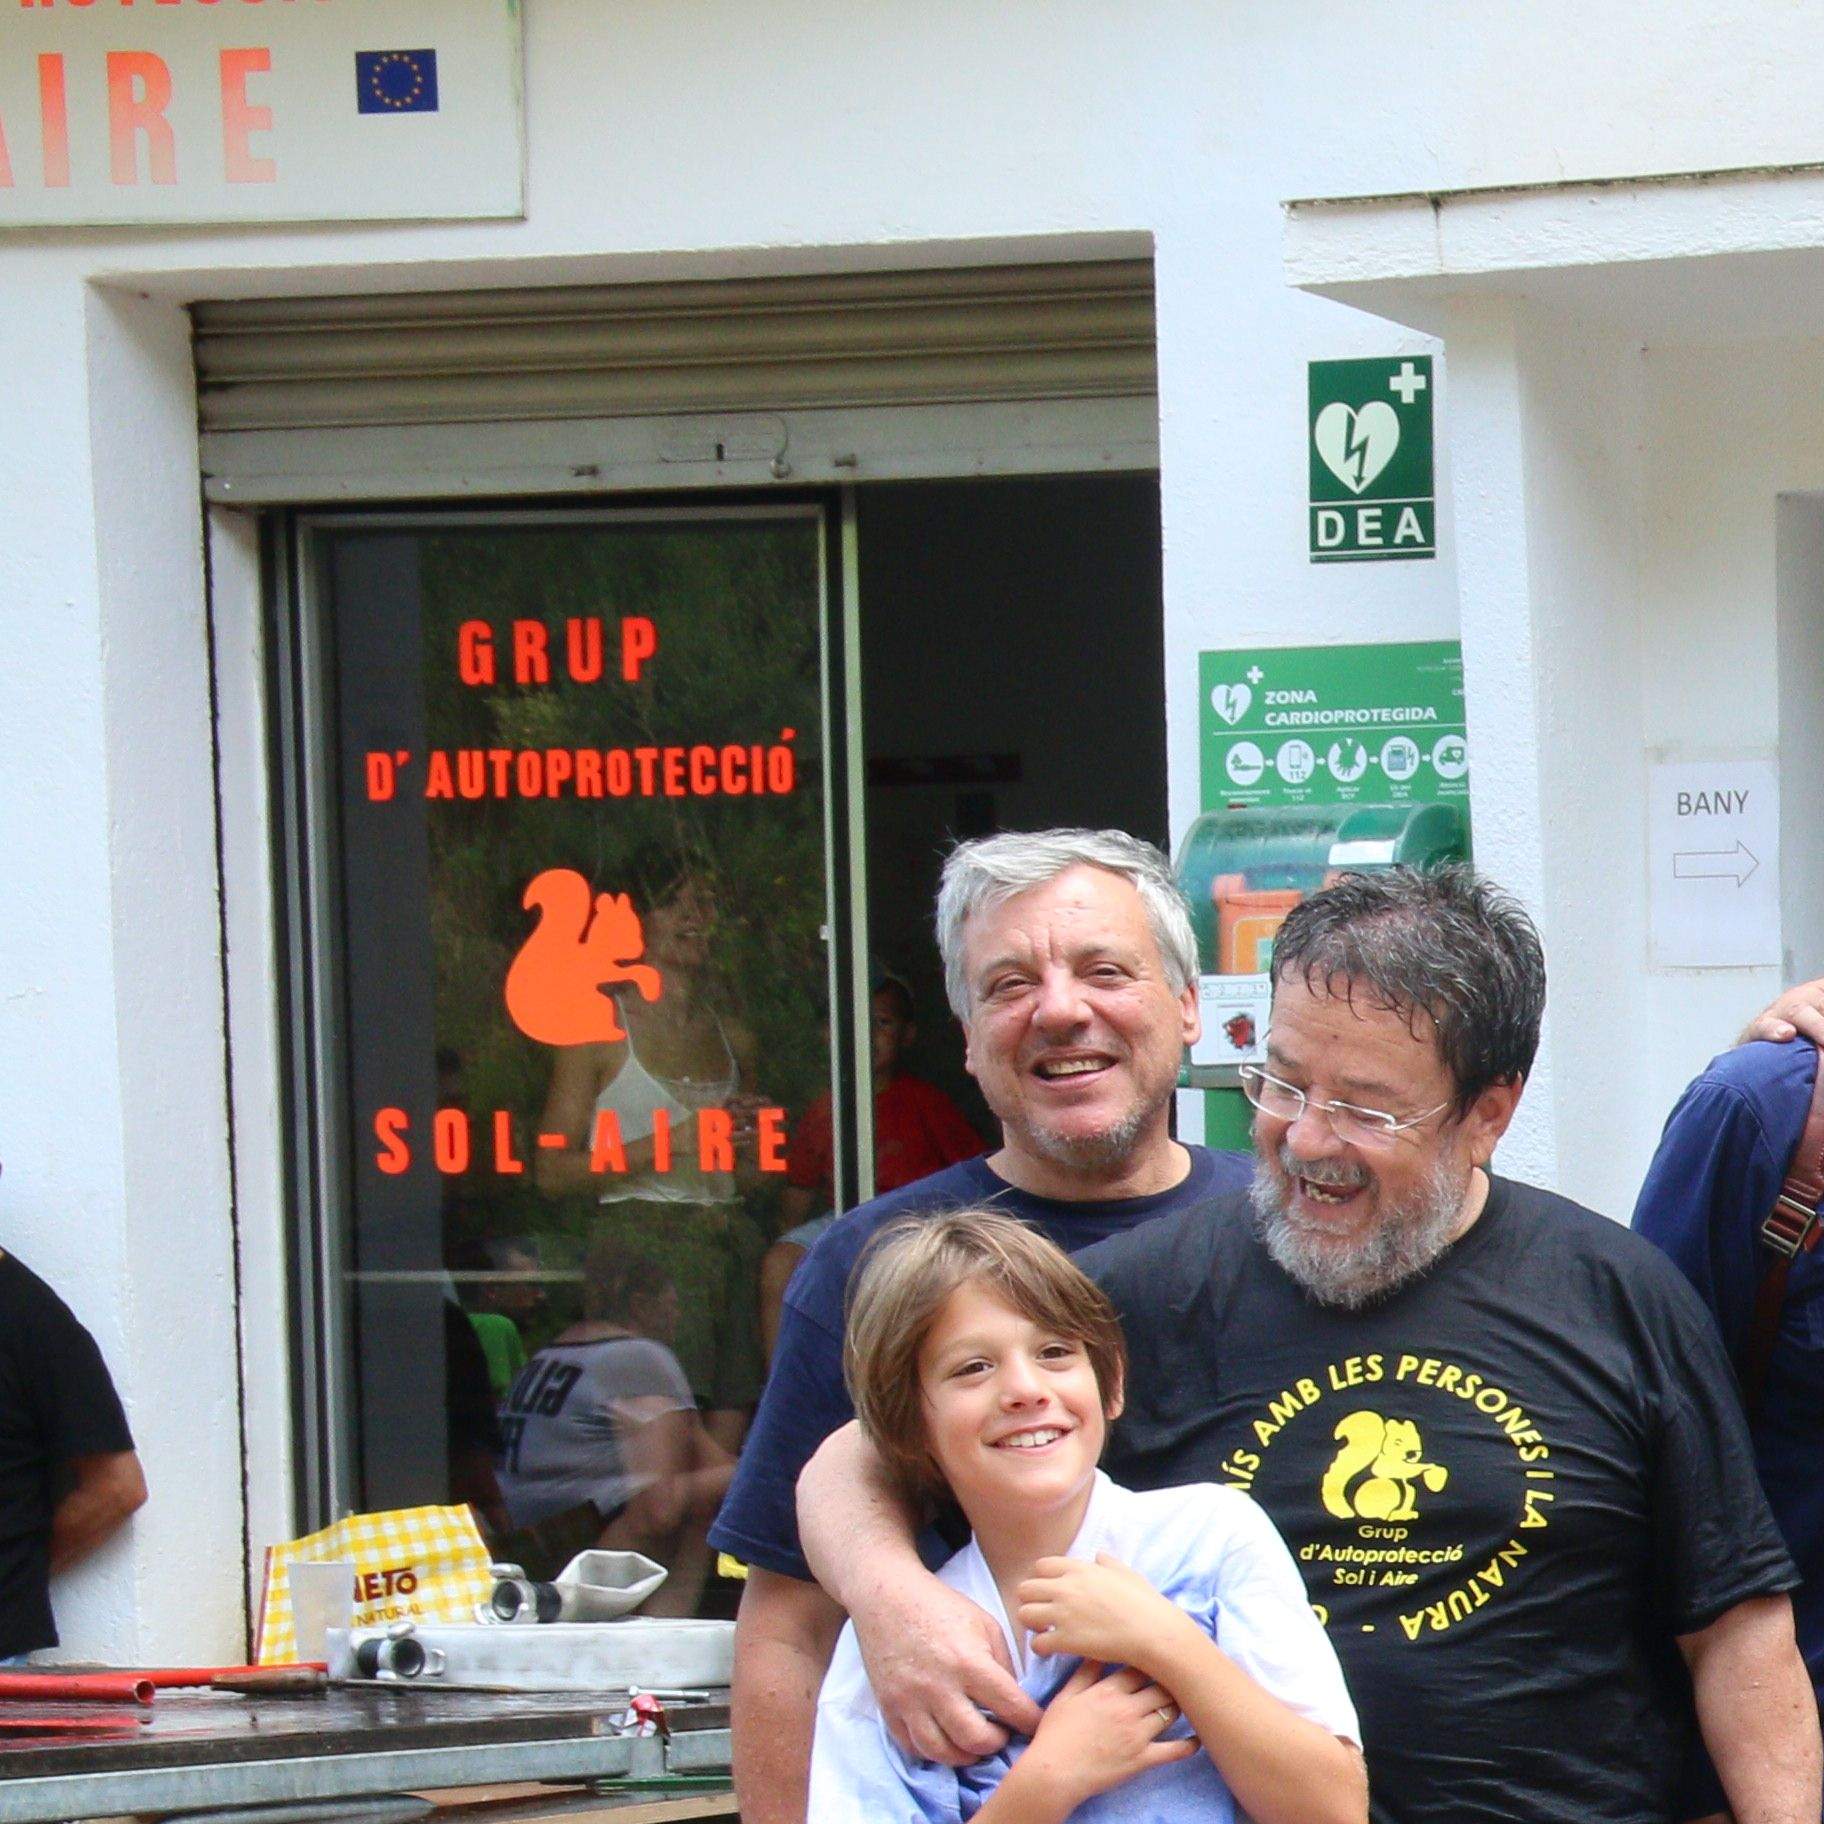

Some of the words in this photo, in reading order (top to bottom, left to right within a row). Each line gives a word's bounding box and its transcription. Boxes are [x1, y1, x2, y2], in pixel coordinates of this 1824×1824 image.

[0, 47, 278, 188] IRE
[1316, 506, 1426, 548] DEA
[457, 615, 658, 687] GRUP
[1264, 689, 1318, 705] ZONA
[1264, 706, 1438, 726] CARDIOPROTEGIDA
[364, 726, 798, 802] D'AUTOPROTECCIÓ
[1676, 789, 1750, 816] BANY
[372, 1105, 790, 1176] SOL-AIRE
[1328, 1353, 1385, 1392] LES
[1251, 1376, 1322, 1448] AMB
[1396, 1354, 1550, 1462] PERSONES
[1519, 1487, 1555, 1529] LA
[1299, 1543, 1464, 1565] d'Autoprotecció
[1357, 1524, 1409, 1542] Grup
[1332, 1568, 1366, 1586] Sol
[1379, 1570, 1419, 1587] Aire
[1400, 1538, 1529, 1641] NATURA
